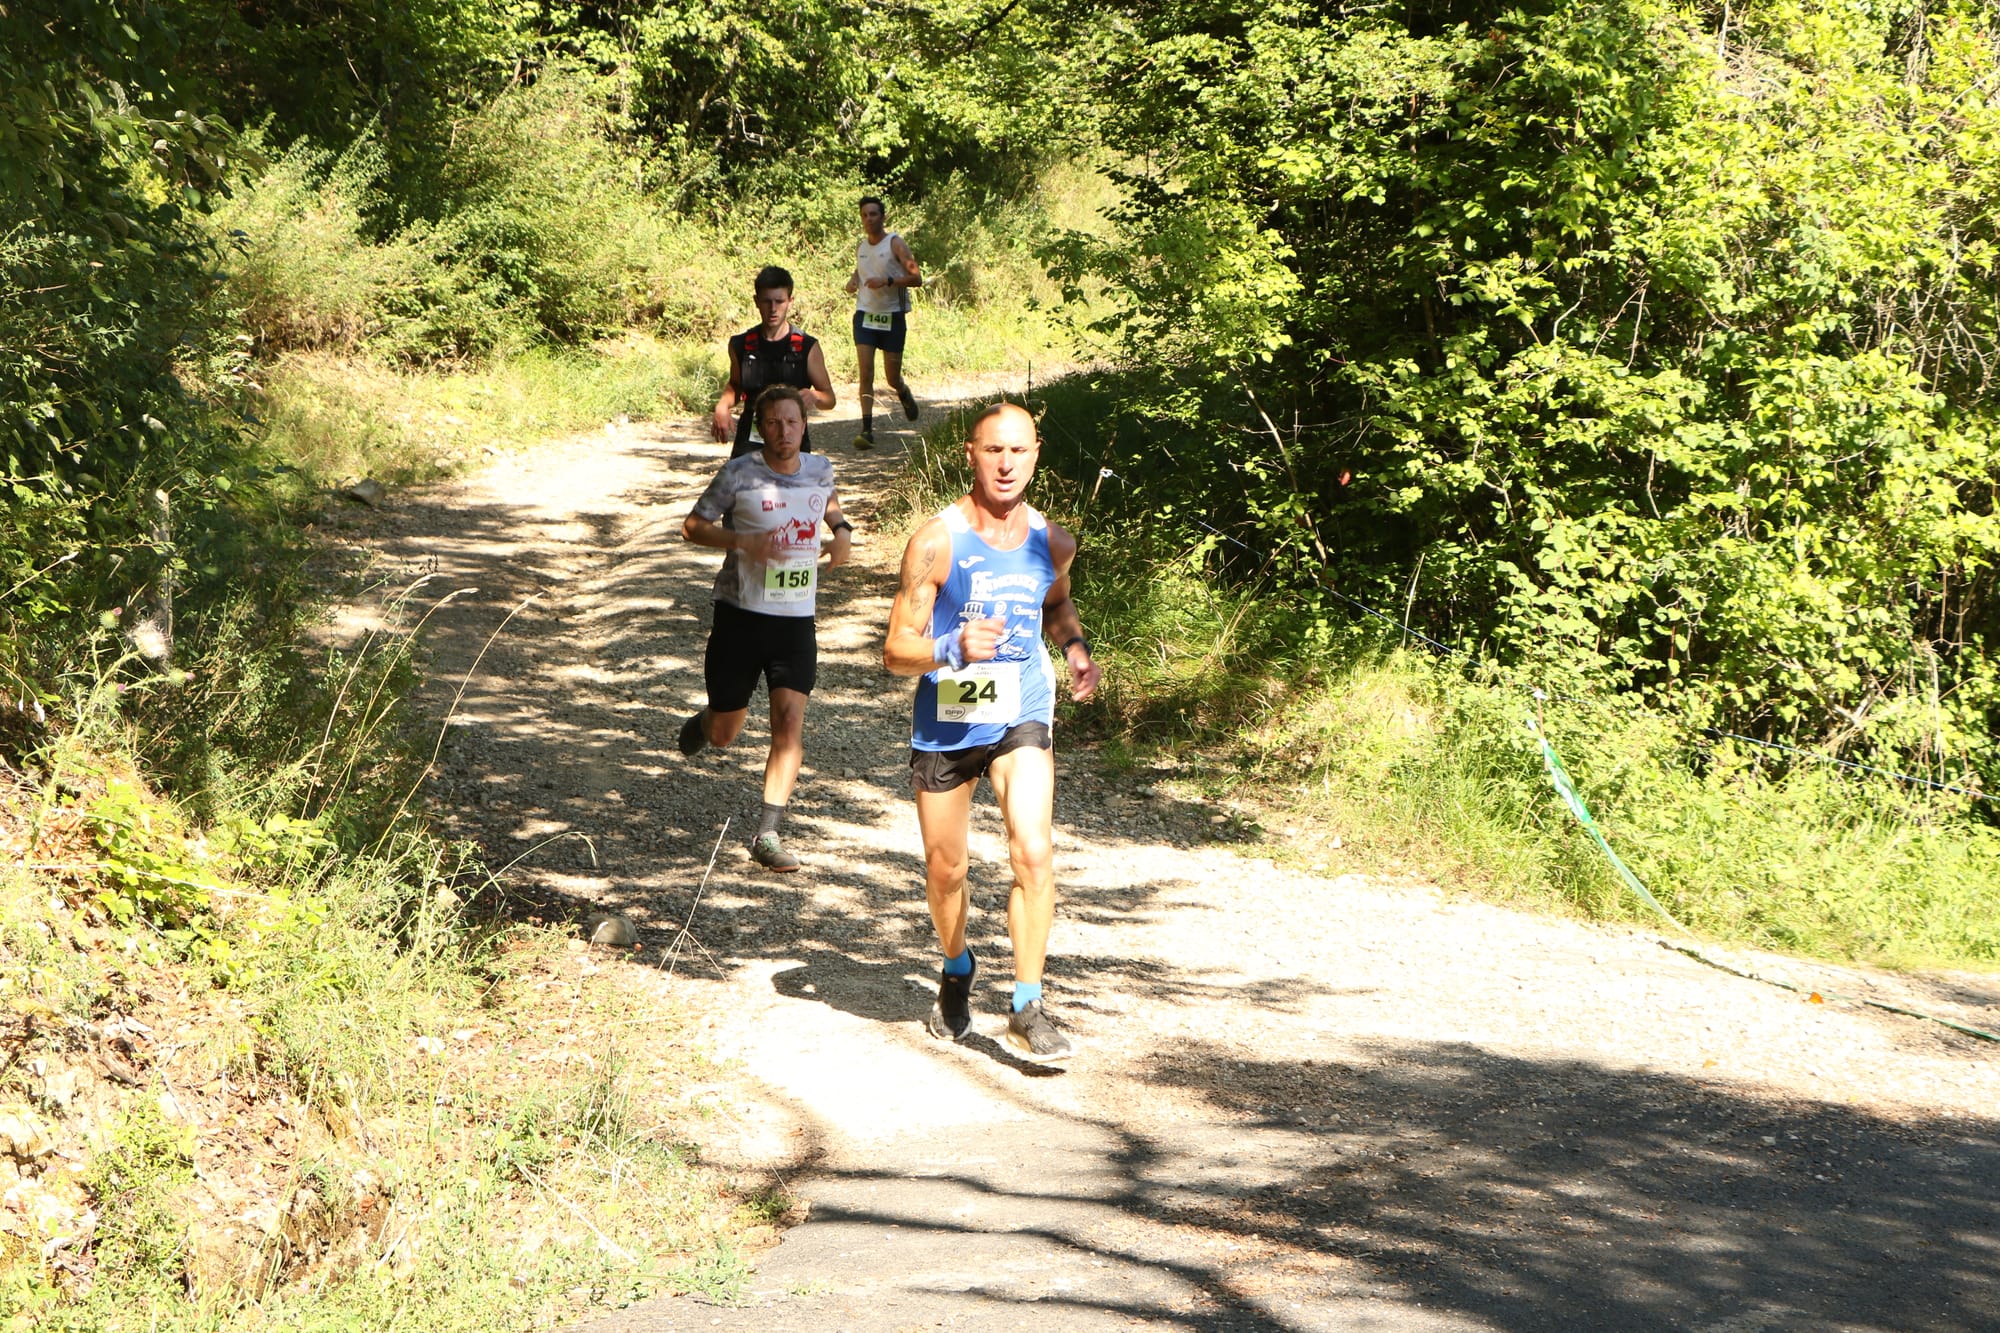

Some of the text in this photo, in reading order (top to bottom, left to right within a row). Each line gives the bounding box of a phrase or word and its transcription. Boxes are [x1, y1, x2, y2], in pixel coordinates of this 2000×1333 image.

[868, 314, 889, 324] 140
[775, 570, 809, 588] 158
[958, 680, 998, 704] 24
